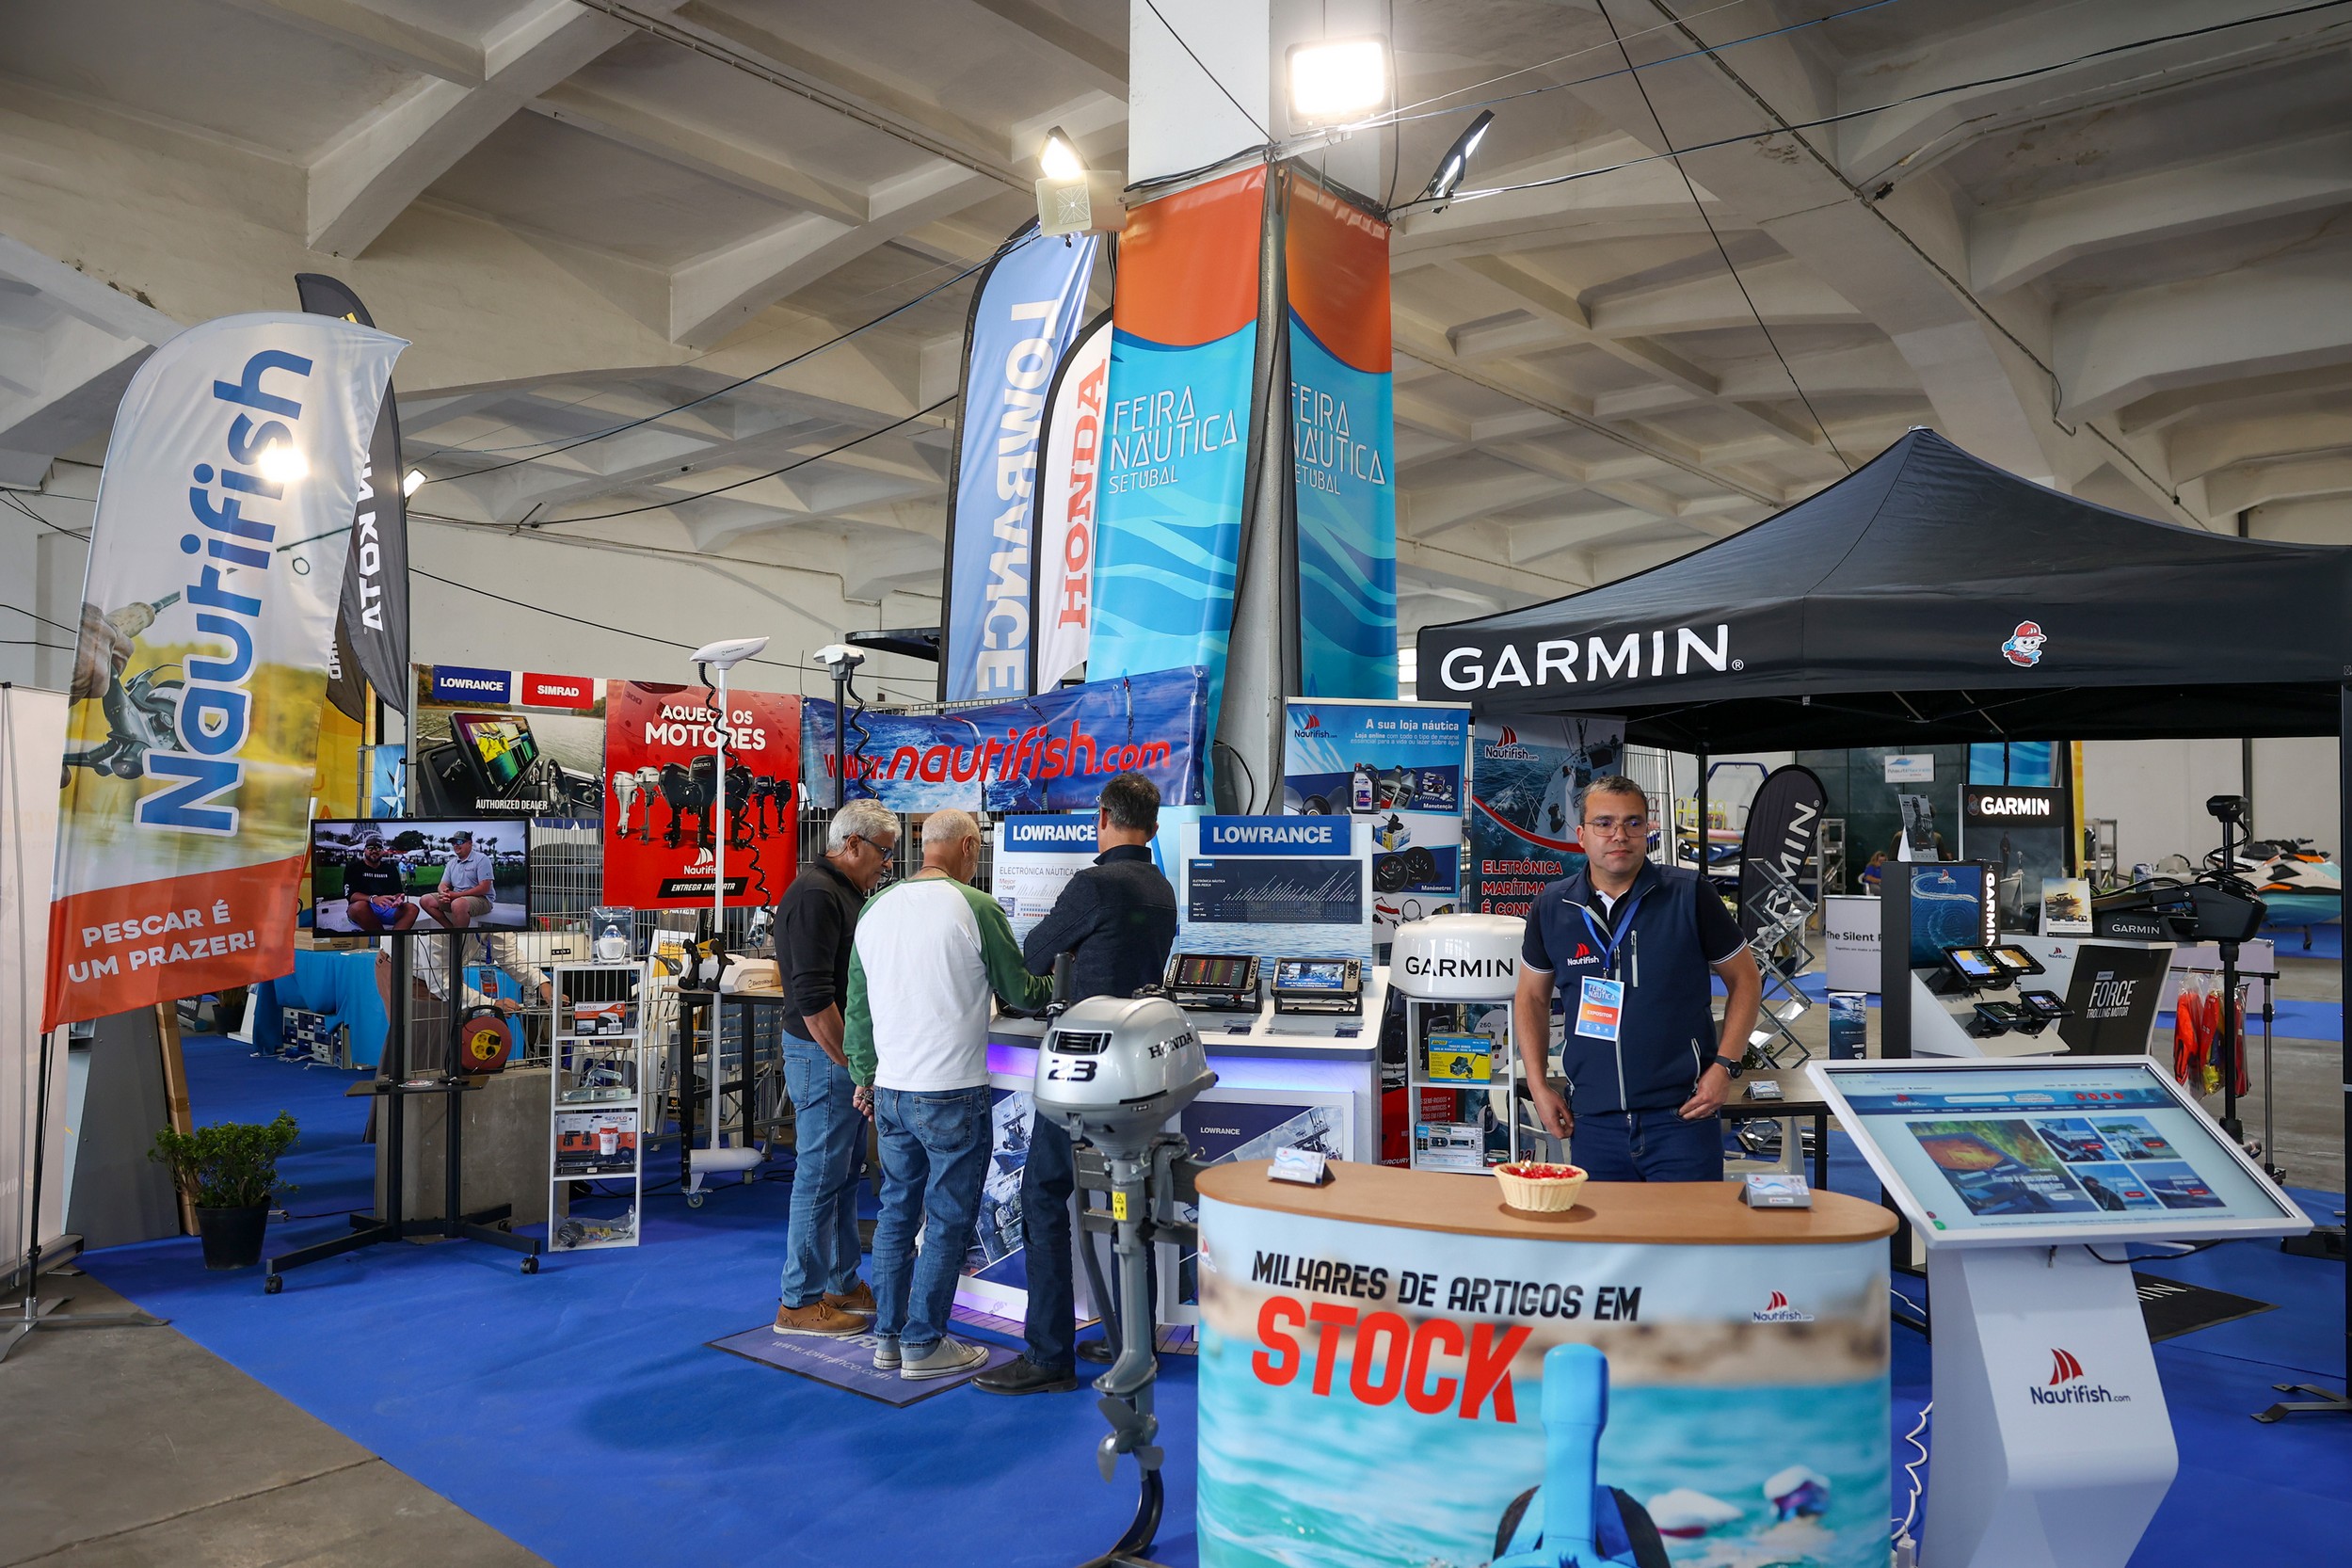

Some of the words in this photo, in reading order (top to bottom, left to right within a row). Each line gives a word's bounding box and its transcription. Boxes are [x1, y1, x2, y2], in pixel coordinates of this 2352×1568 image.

[1112, 385, 1195, 435] FEIRA
[1111, 408, 1238, 470] NÁUTICA
[1108, 470, 1179, 495] SETÚBAL
[1295, 462, 1341, 495] ETÚBAL
[1058, 360, 1107, 631] HONDA
[138, 349, 313, 832] Nautifish
[1440, 624, 1729, 692] GARMIN
[440, 678, 504, 693] LOWRANCE
[536, 684, 580, 698] SIMRAD
[661, 705, 729, 726] AQUEÇ
[732, 710, 754, 725] OS
[1366, 719, 1374, 729] A
[1378, 721, 1396, 729] sua
[1400, 720, 1418, 731] loja
[1422, 719, 1459, 731] náutica
[646, 722, 766, 751] MOTORES
[475, 799, 520, 810] AUTHORIZED
[521, 799, 548, 811] DEALER
[1980, 796, 2050, 816] GARMIN
[1013, 824, 1097, 841] LOWRANCE
[1213, 826, 1333, 843] LOWRANCE
[684, 865, 717, 875] Nautifis
[1000, 866, 1044, 876] ELECTRÓNICA
[1046, 865, 1074, 876] NÁUTICA
[1481, 857, 1563, 875] ELETRÓNICA
[671, 884, 702, 892] ENTREGA
[702, 882, 736, 892] IMEATA
[1481, 878, 1545, 896] MARÍTIMA
[1756, 801, 1817, 971] RMIN
[1481, 899, 1491, 915] É
[1496, 903, 1532, 917] CONN
[1986, 872, 1996, 947] GARMIN
[82, 908, 203, 949] PESCAR
[212, 899, 232, 924] É
[2112, 923, 2160, 935] GARMIN
[1827, 931, 1841, 940] The
[1843, 931, 1875, 941] Silent
[67, 956, 120, 984] UM
[128, 930, 256, 970] PRAZER!
[1405, 956, 1514, 978] GARMIN
[1567, 955, 1600, 967] Nautifish
[1167, 958, 1178, 982] LOWRANCE
[2088, 980, 2136, 1008] FORCE
[1587, 1010, 1613, 1019] EXPOSITOR
[2086, 1007, 2111, 1019] TROLLING
[2111, 1006, 2129, 1017] MOTOR
[1147, 1032, 1194, 1059] HONDA
[1200, 1127, 1240, 1135] LOWRANCE
[1252, 1251, 1389, 1301] MILHARES
[1400, 1272, 1437, 1304] DE
[1448, 1277, 1583, 1319] ARTIGOS
[1593, 1286, 1642, 1321] EM
[772, 1340, 893, 1382] www.lowrance.com
[1252, 1296, 1533, 1423] STOCK
[2030, 1384, 2132, 1405] Nautifish.com
